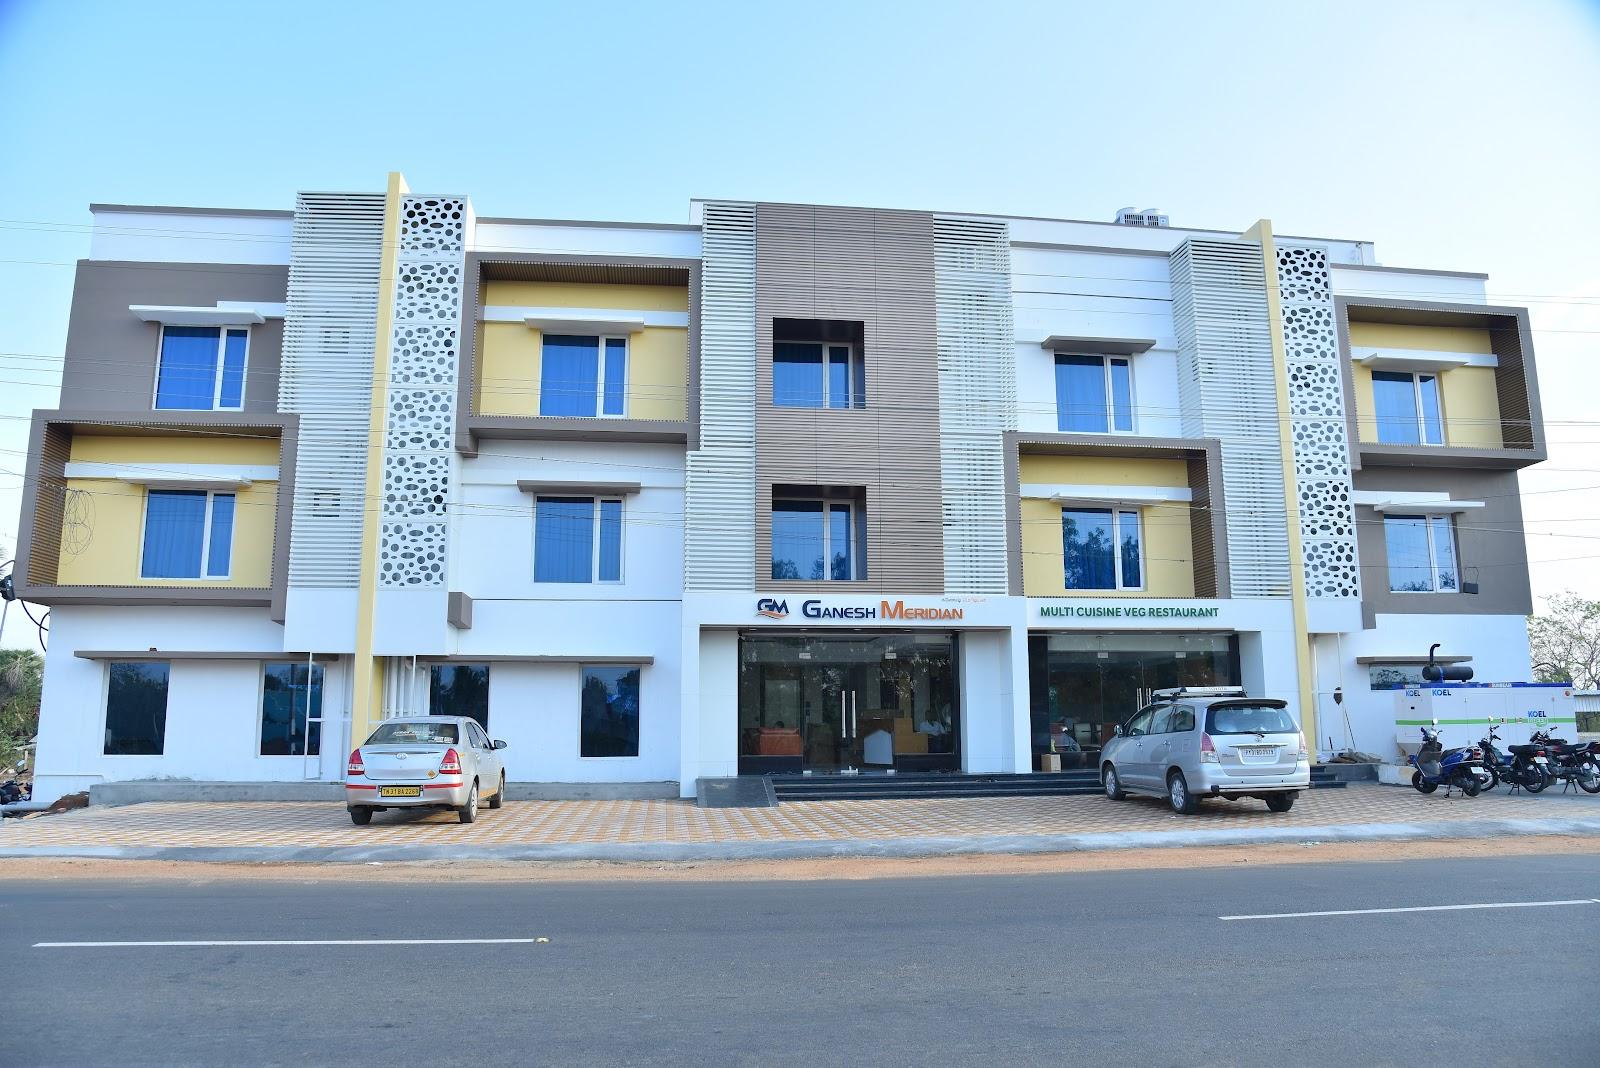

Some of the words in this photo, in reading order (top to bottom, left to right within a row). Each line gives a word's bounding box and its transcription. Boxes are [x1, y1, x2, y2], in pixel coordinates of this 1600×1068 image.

[757, 598, 789, 614] GM
[802, 600, 876, 619] GANESH
[881, 601, 963, 619] MERIDIAN
[1040, 607, 1073, 618] MULTI
[1076, 607, 1121, 618] CUISINE
[1124, 607, 1146, 618] VEG
[1148, 608, 1219, 619] RESTAURANT
[1432, 689, 1451, 697] KOEL
